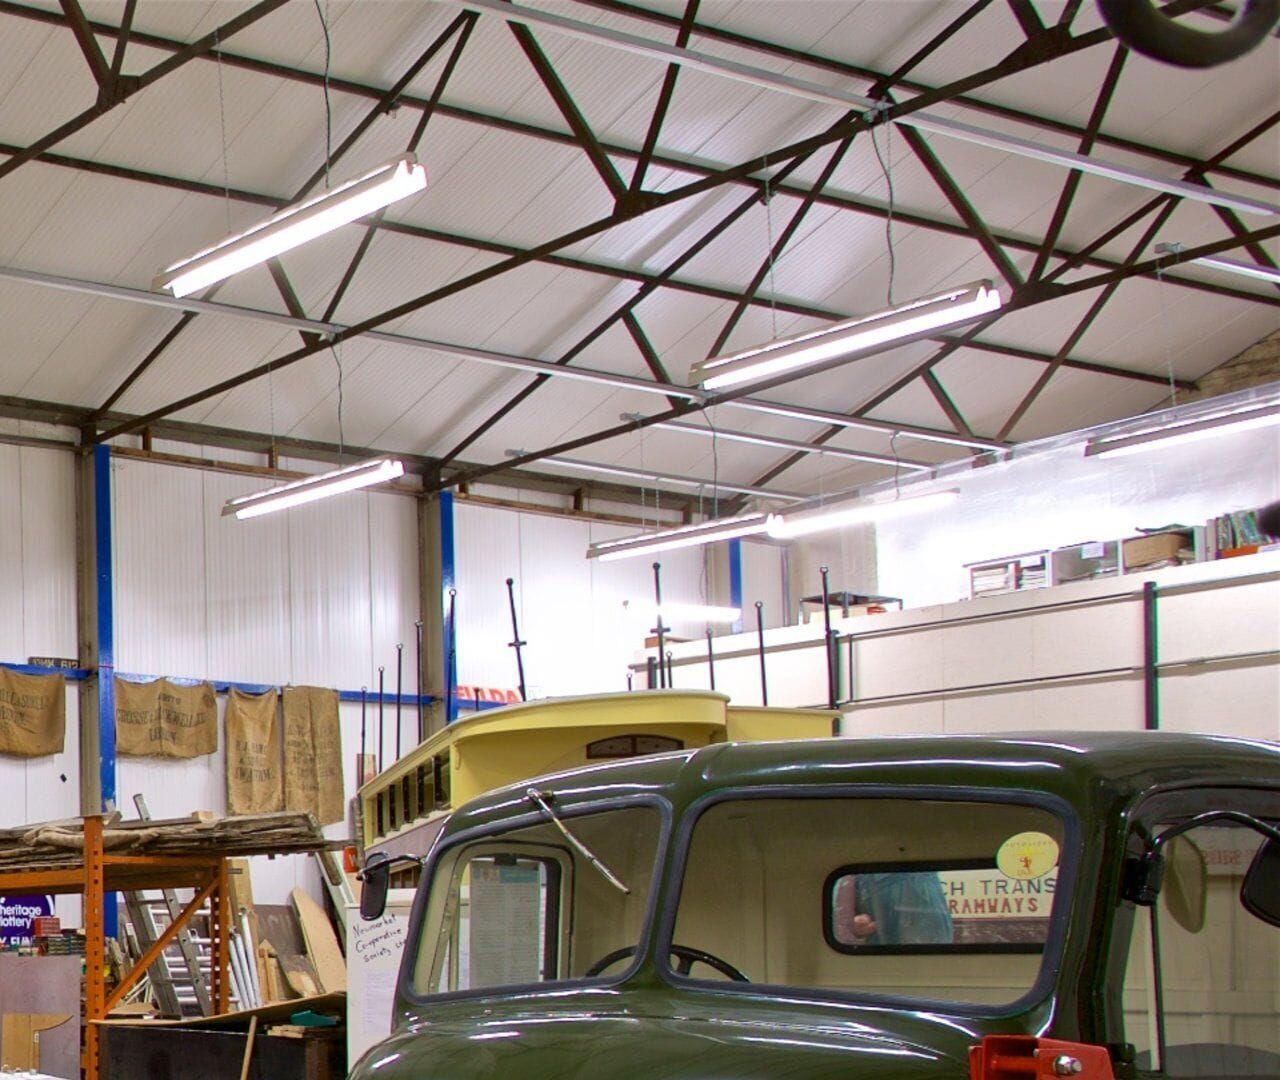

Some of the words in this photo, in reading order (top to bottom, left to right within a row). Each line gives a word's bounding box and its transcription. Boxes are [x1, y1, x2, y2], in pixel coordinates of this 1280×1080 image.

[980, 878, 1056, 896] TRANS
[0, 905, 43, 917] heritage
[0, 916, 32, 929] lottery
